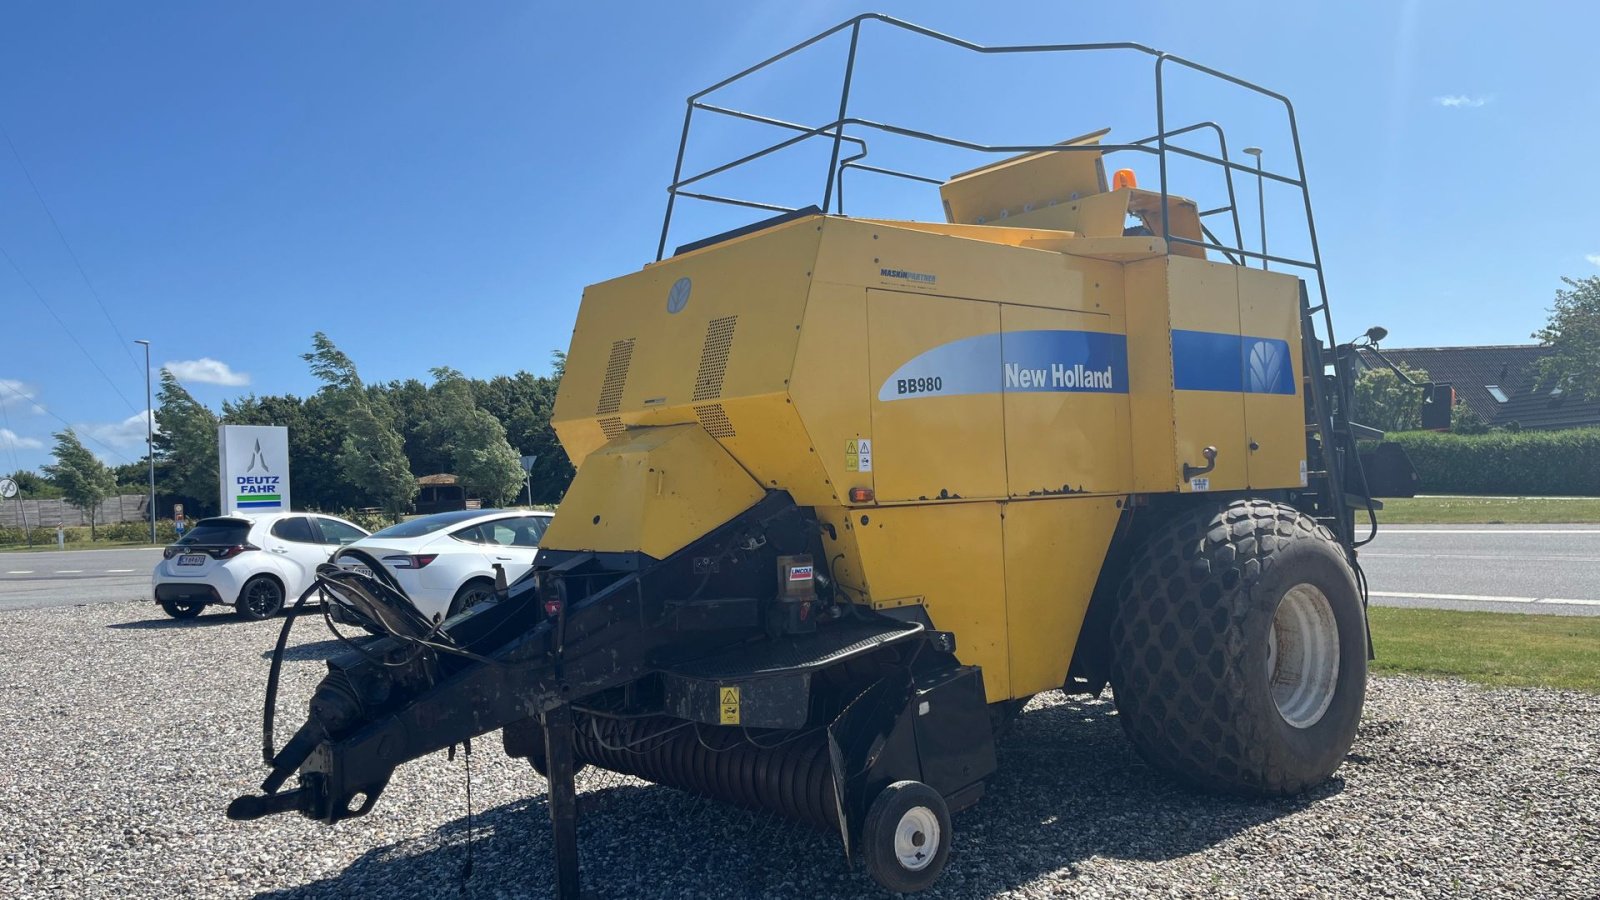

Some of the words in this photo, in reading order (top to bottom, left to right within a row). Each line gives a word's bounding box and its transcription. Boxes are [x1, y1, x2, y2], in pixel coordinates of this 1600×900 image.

[1004, 363, 1047, 388] New
[1051, 363, 1113, 389] Holland
[897, 376, 942, 395] BB980
[237, 476, 280, 485] DEUTZ
[241, 485, 276, 493] FAHR
